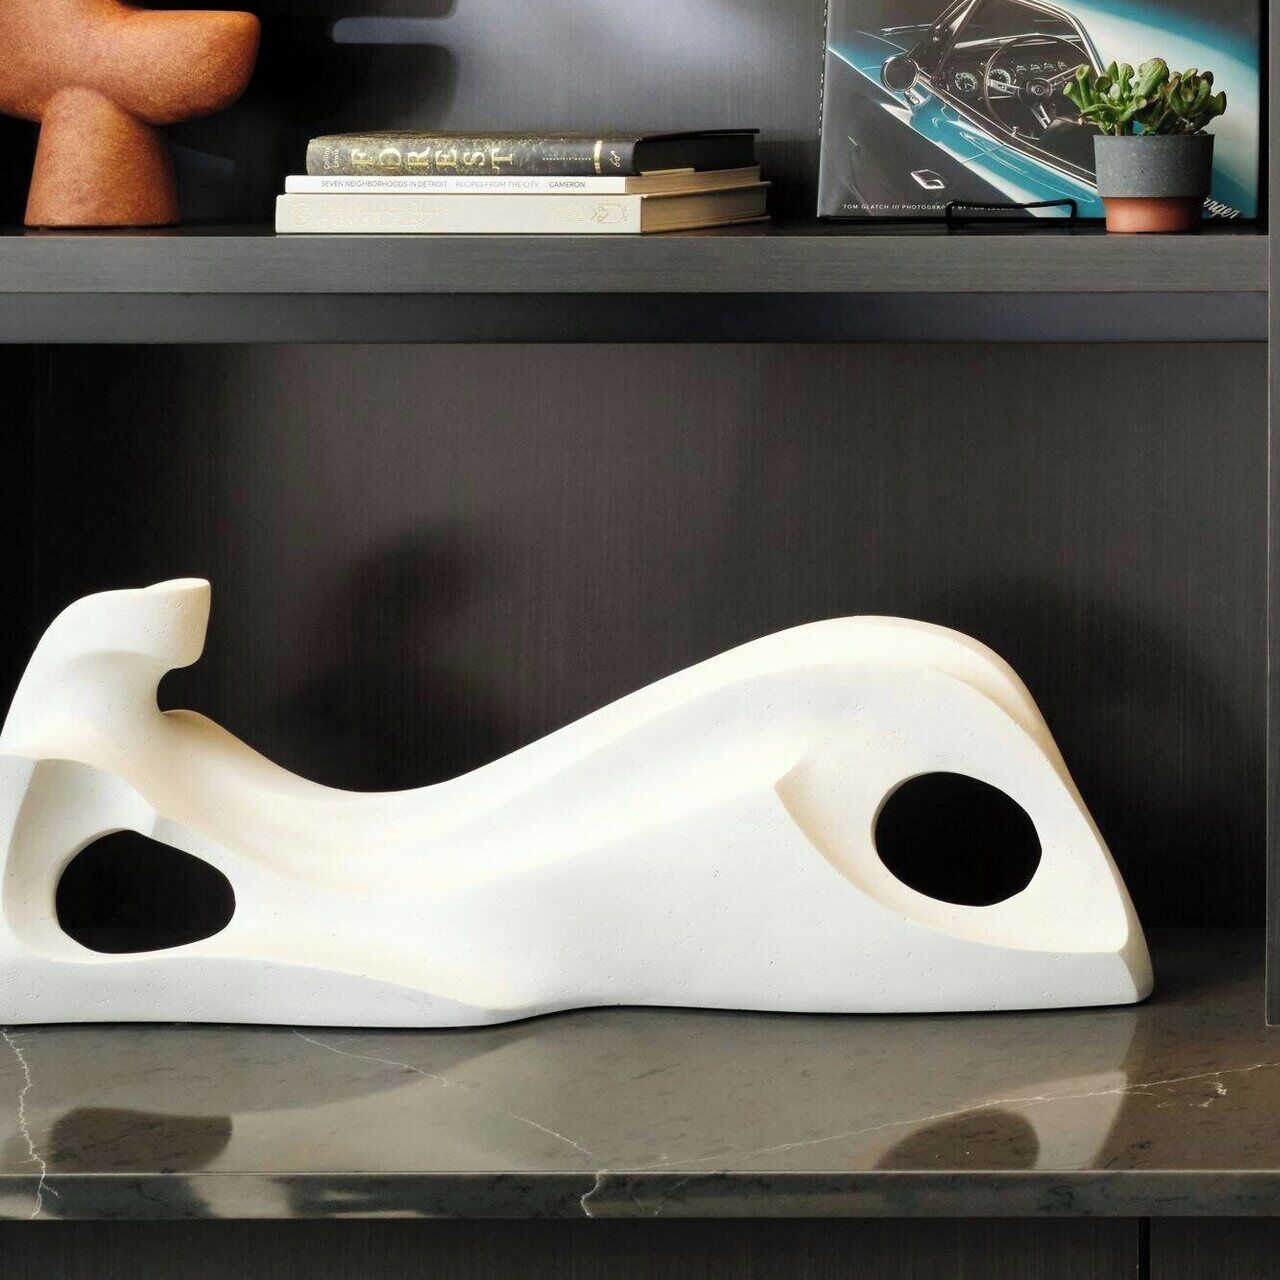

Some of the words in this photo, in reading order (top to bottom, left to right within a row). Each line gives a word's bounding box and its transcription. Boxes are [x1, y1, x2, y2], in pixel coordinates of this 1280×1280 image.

[351, 146, 513, 174] FOREST
[321, 180, 344, 188] SEVEN
[344, 180, 408, 188] NEIGHBORHOODS
[408, 180, 417, 188] IN
[417, 180, 449, 188] DETROIT
